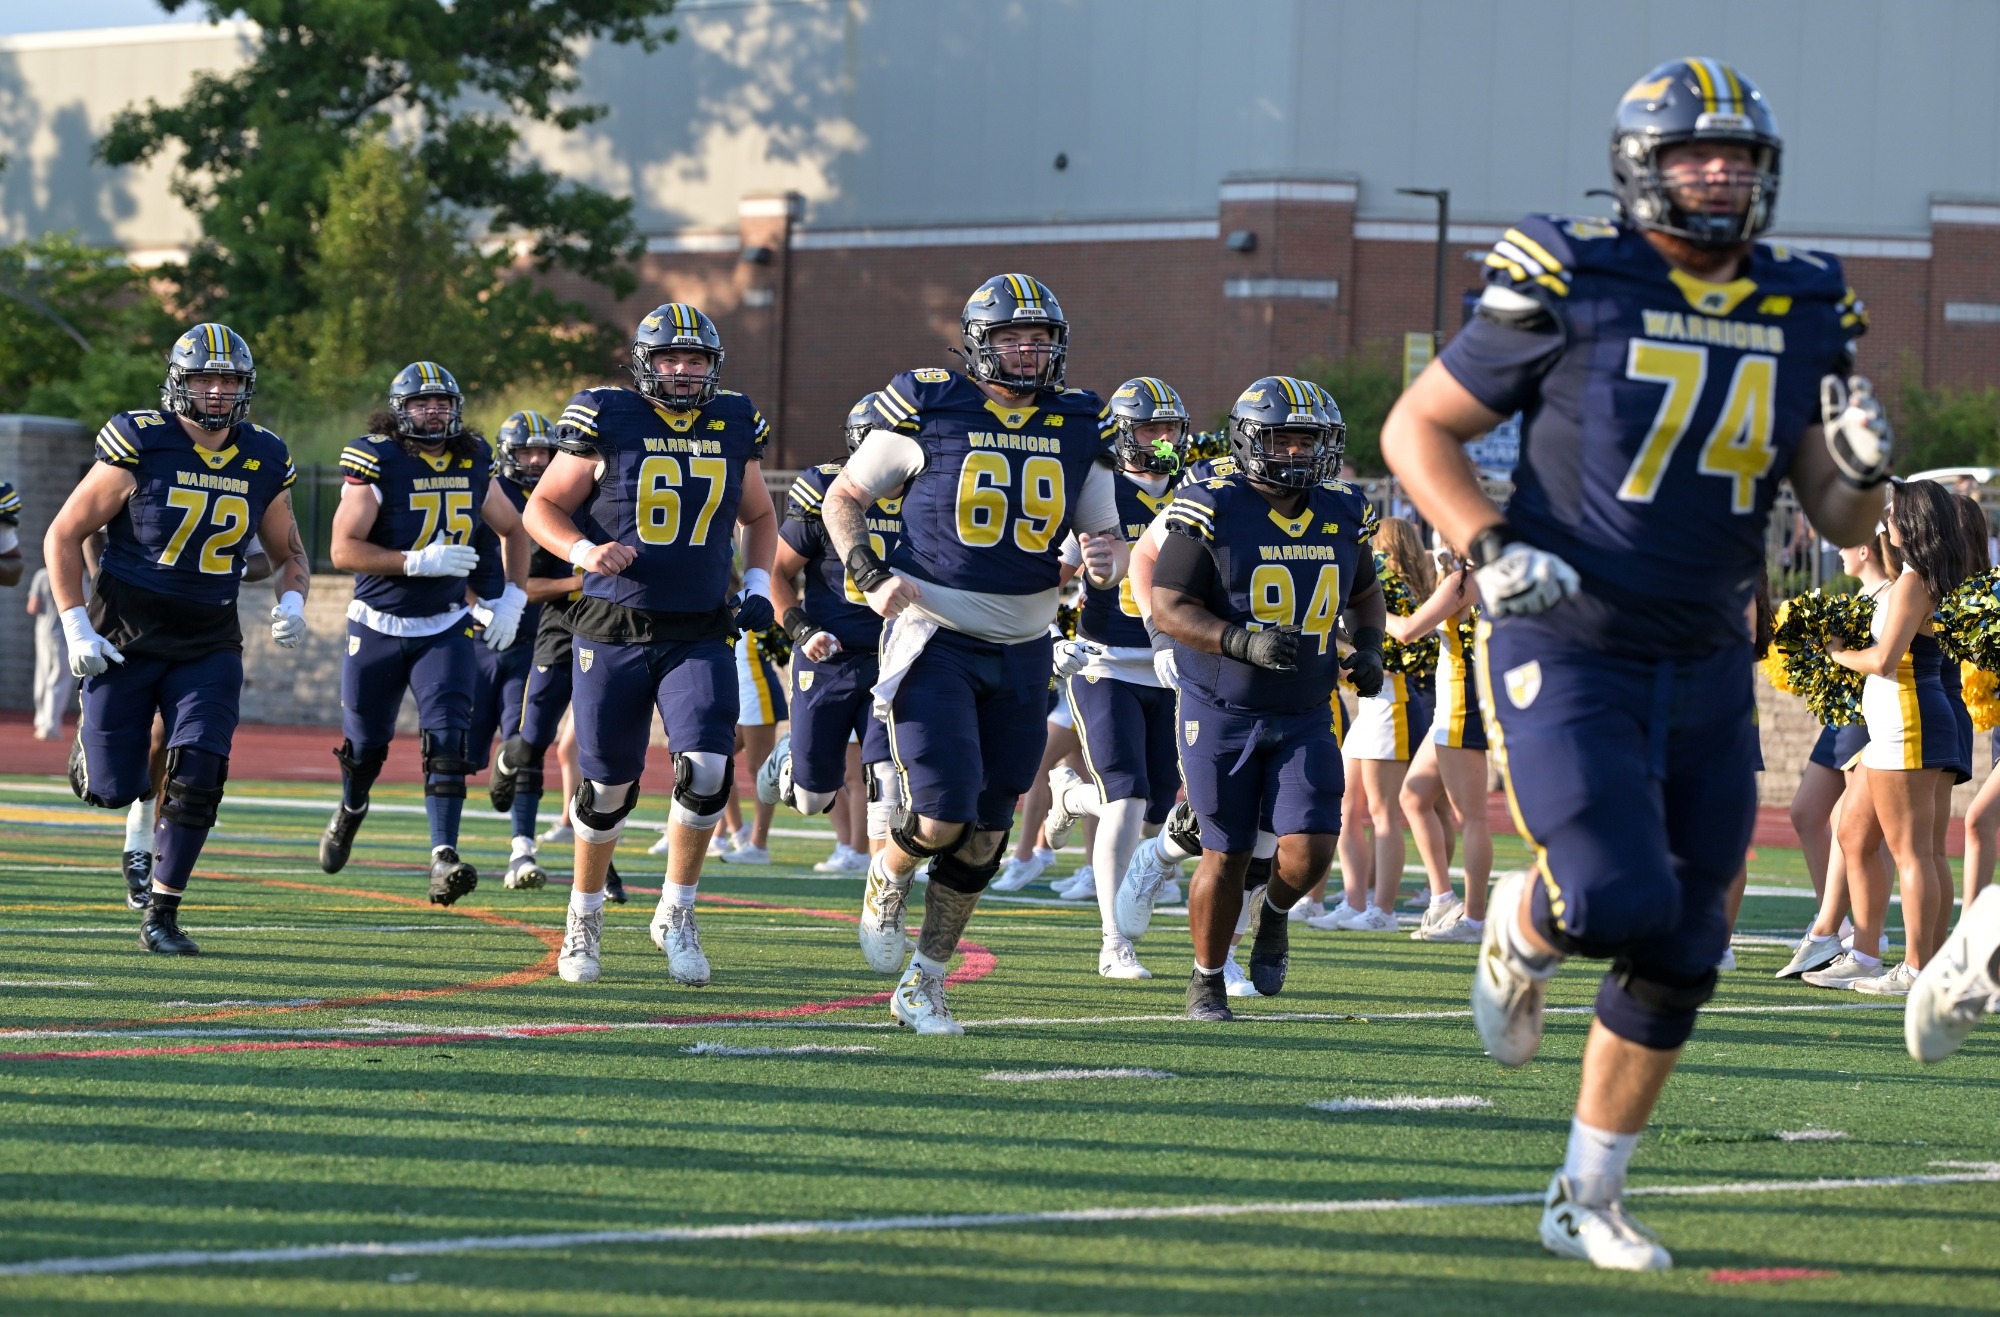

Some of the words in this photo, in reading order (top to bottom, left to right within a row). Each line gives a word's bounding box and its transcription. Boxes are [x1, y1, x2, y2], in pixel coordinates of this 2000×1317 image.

[1640, 309, 1786, 354] WARRIORS
[967, 431, 1061, 454] WARRIORS
[1616, 336, 1779, 515] 74
[176, 470, 249, 494] WARRIORS
[412, 476, 470, 491] WARRIORS
[635, 455, 728, 547] 67
[955, 450, 1067, 554] 69
[157, 486, 250, 575] 72
[409, 491, 473, 551] 75
[1258, 544, 1336, 561] WARRIORS
[1246, 563, 1341, 656] 94
